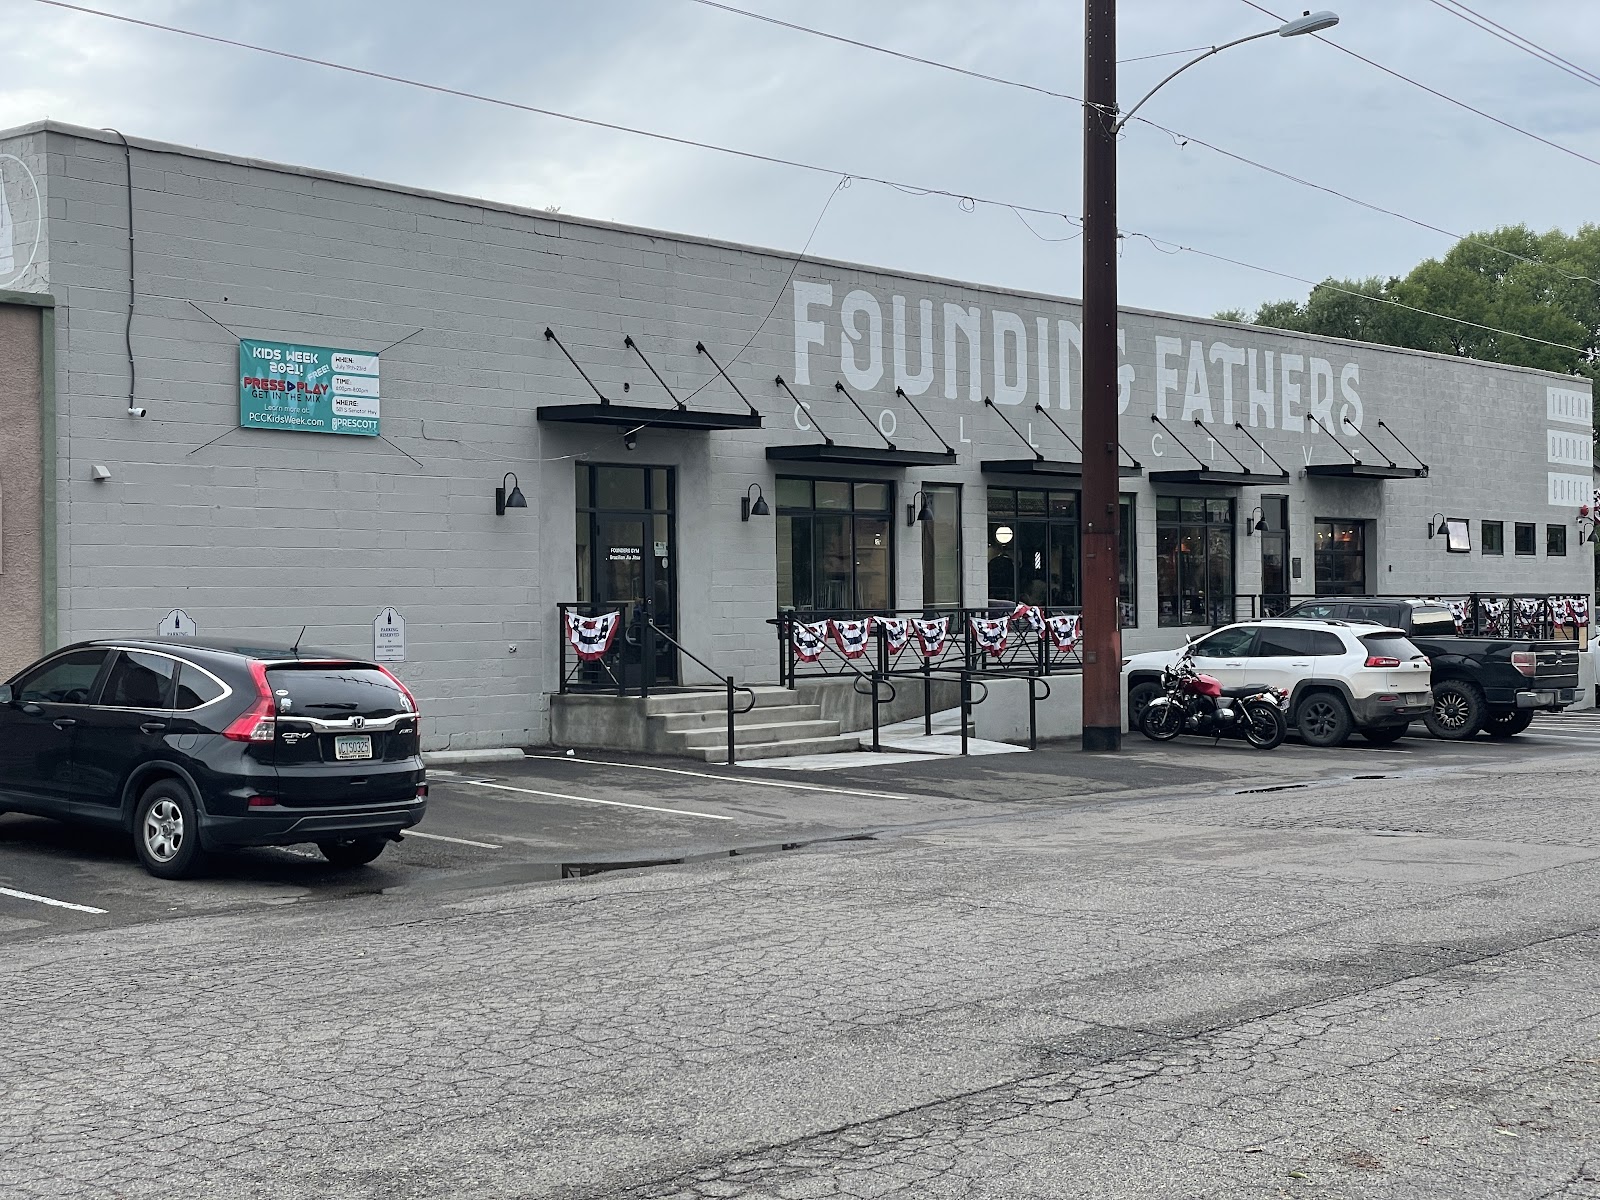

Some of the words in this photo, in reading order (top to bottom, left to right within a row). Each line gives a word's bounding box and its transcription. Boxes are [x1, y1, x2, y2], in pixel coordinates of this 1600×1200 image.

[252, 347, 281, 360] KIDS
[286, 350, 319, 364] WEEK
[269, 361, 304, 376] 2021!
[307, 364, 331, 382] FREE!
[243, 376, 286, 392] PRESS
[296, 381, 329, 395] PLAY
[1155, 335, 1363, 437] FATHERS
[252, 390, 269, 399] GET
[272, 391, 282, 400] IN
[286, 392, 302, 402] THE
[305, 394, 321, 403] MIX
[264, 403, 283, 412] Learn
[284, 406, 301, 414] more
[1552, 394, 1589, 419] TAVERN
[249, 412, 324, 426] PCCKidsWeek.com
[337, 418, 378, 428] PRESCOTT
[1551, 436, 1590, 461] BARBER
[1553, 479, 1589, 502] COFFEE
